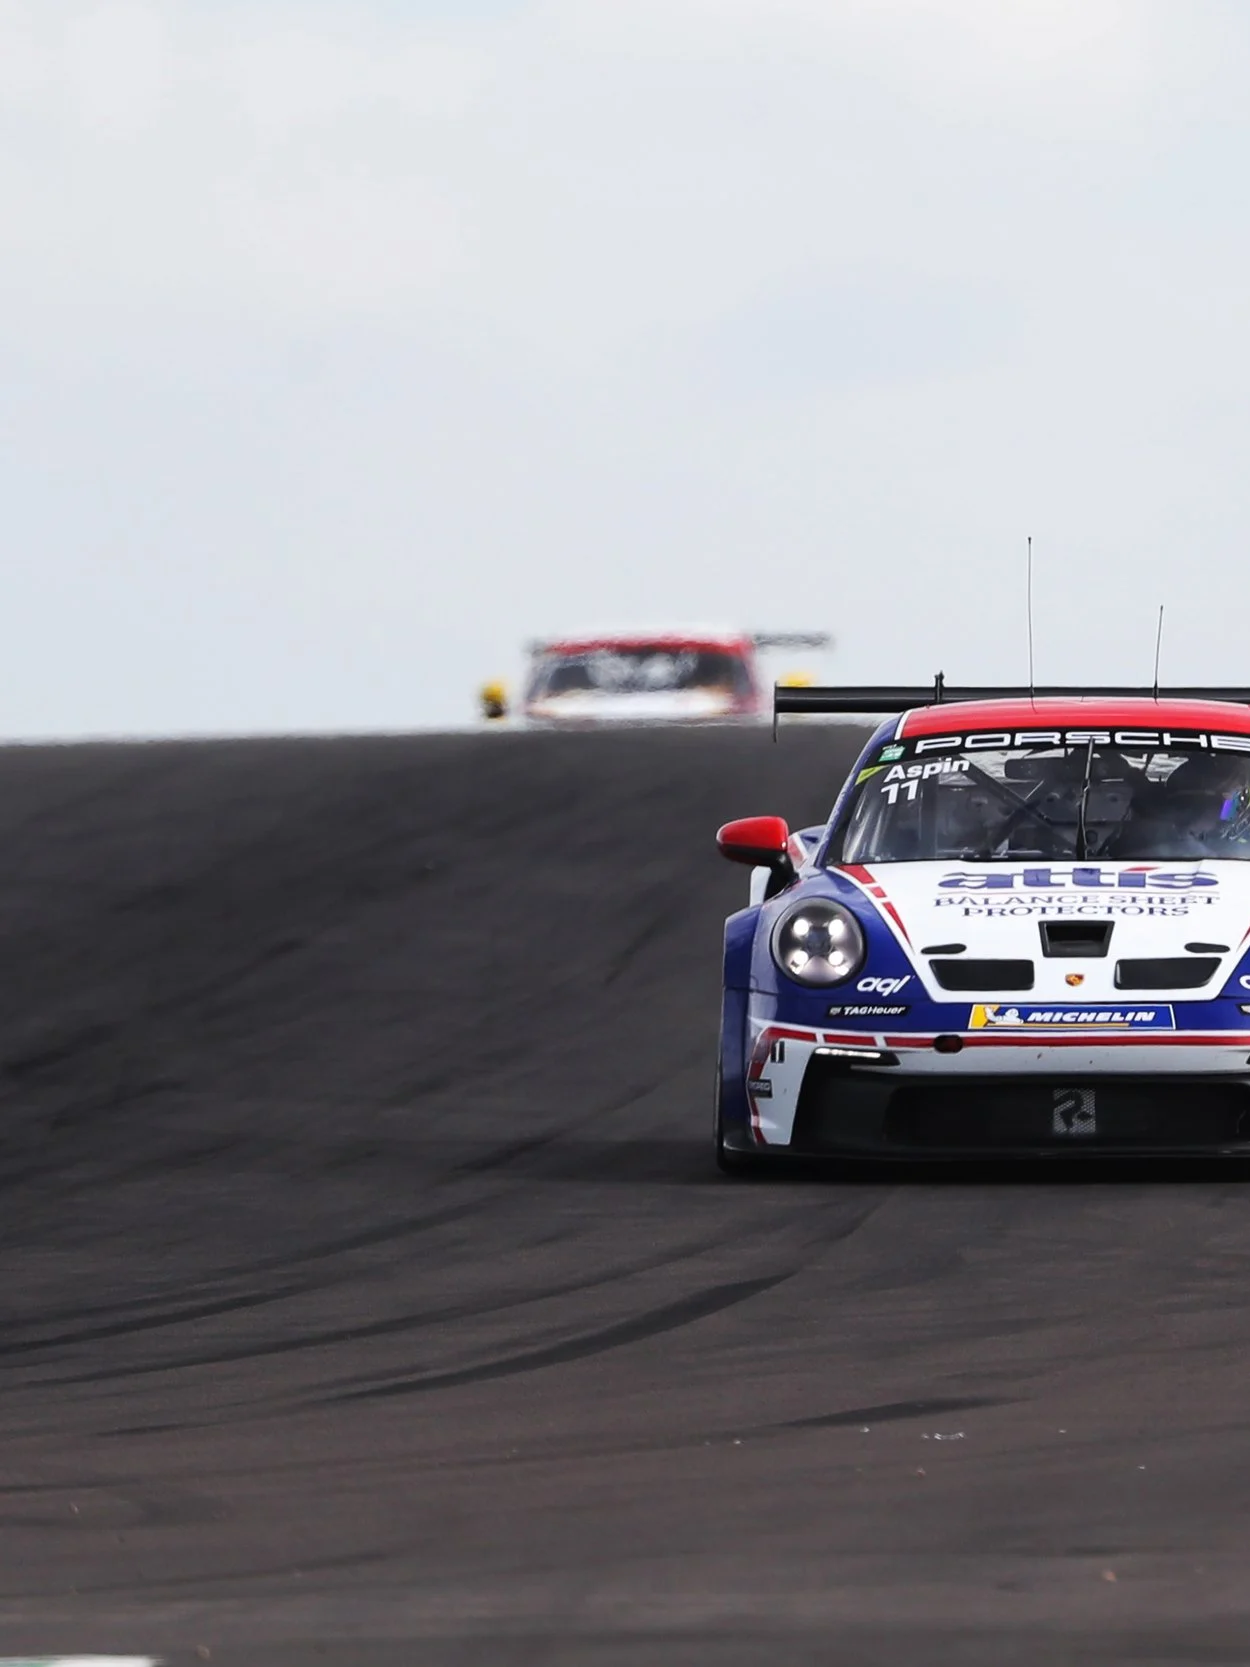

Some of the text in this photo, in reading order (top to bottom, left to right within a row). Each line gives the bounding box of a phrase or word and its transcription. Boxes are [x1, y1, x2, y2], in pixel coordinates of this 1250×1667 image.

[883, 757, 970, 783] Aspin
[881, 779, 919, 805] 11
[938, 866, 1219, 889] attis
[934, 895, 1221, 907] BALANCE SHEET
[961, 905, 1190, 917] PROTECTORS
[856, 975, 911, 997] aql
[1026, 1011, 1156, 1022] MICHELIN
